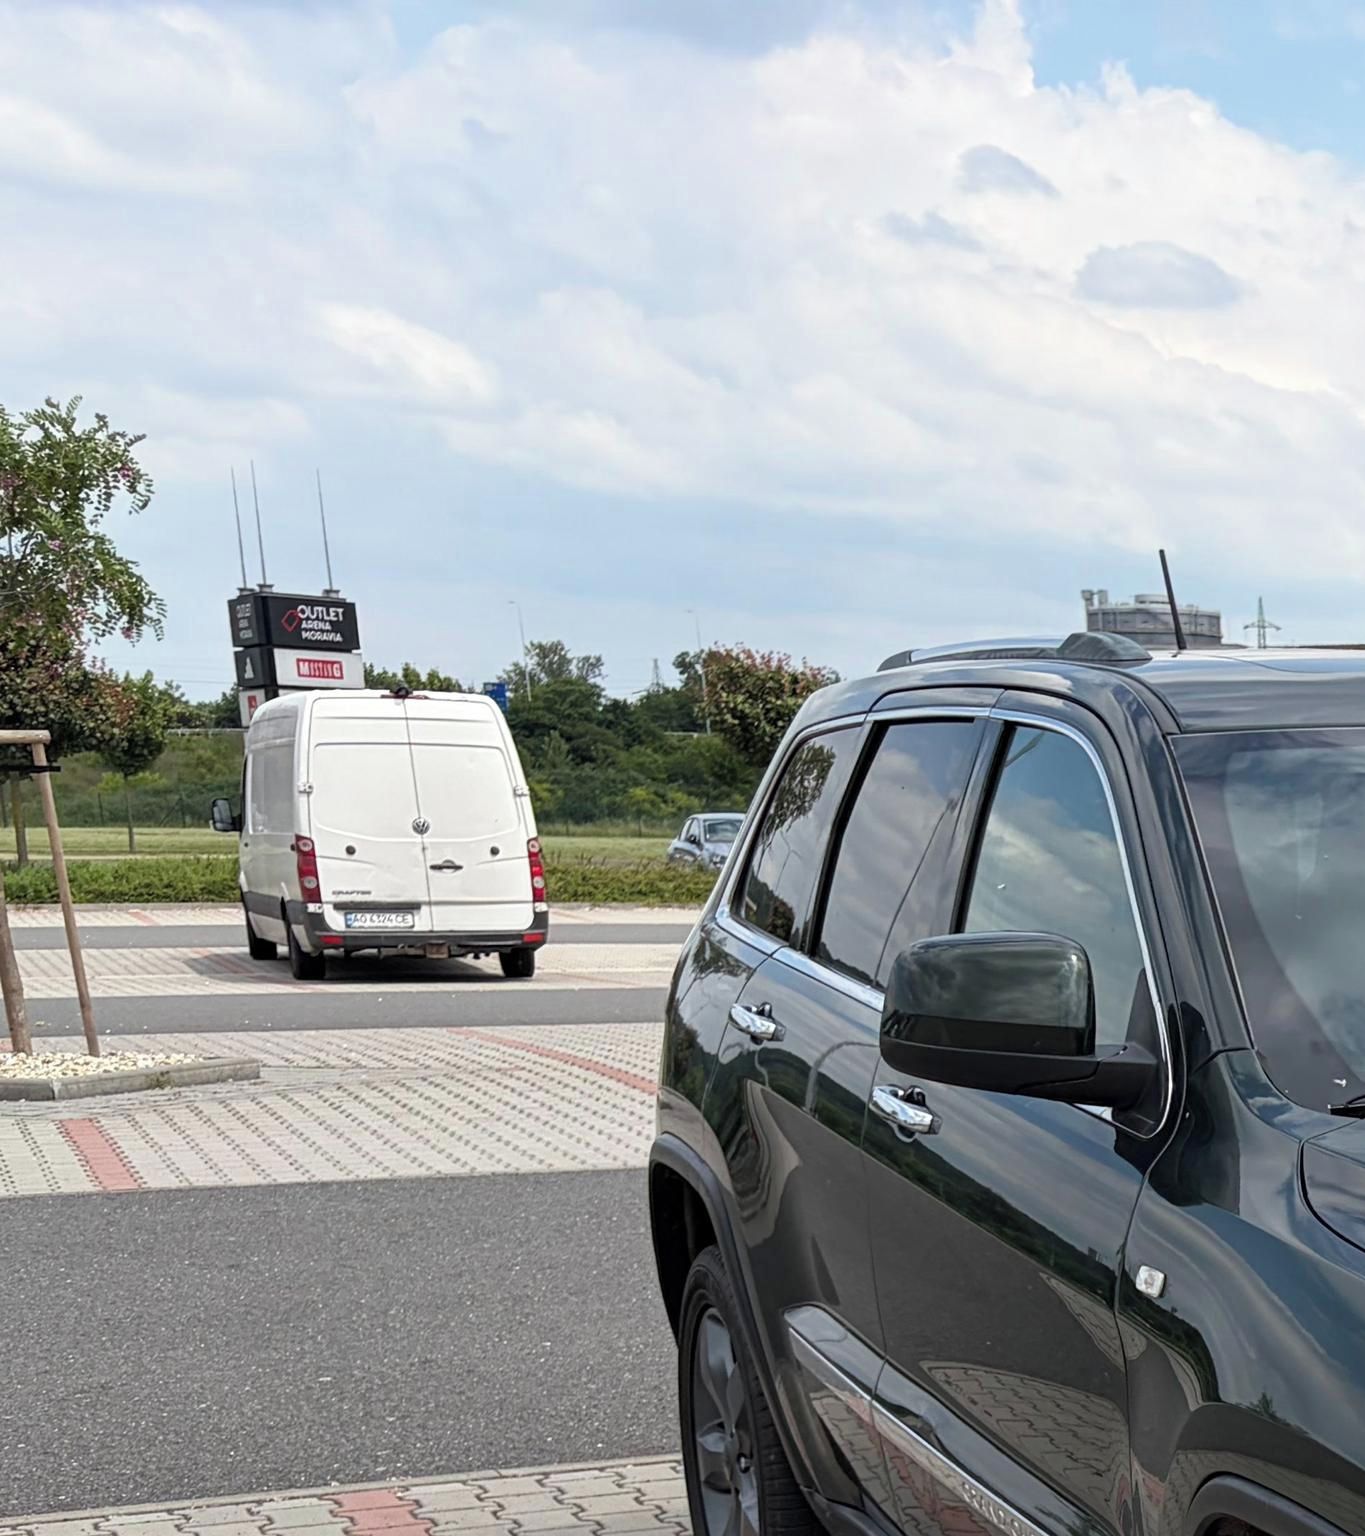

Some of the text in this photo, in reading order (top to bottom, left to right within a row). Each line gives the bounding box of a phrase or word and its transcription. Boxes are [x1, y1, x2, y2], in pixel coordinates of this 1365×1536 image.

[297, 605, 344, 621] OUTLET
[301, 620, 332, 631] ARENA
[301, 630, 343, 642] MORAVIA
